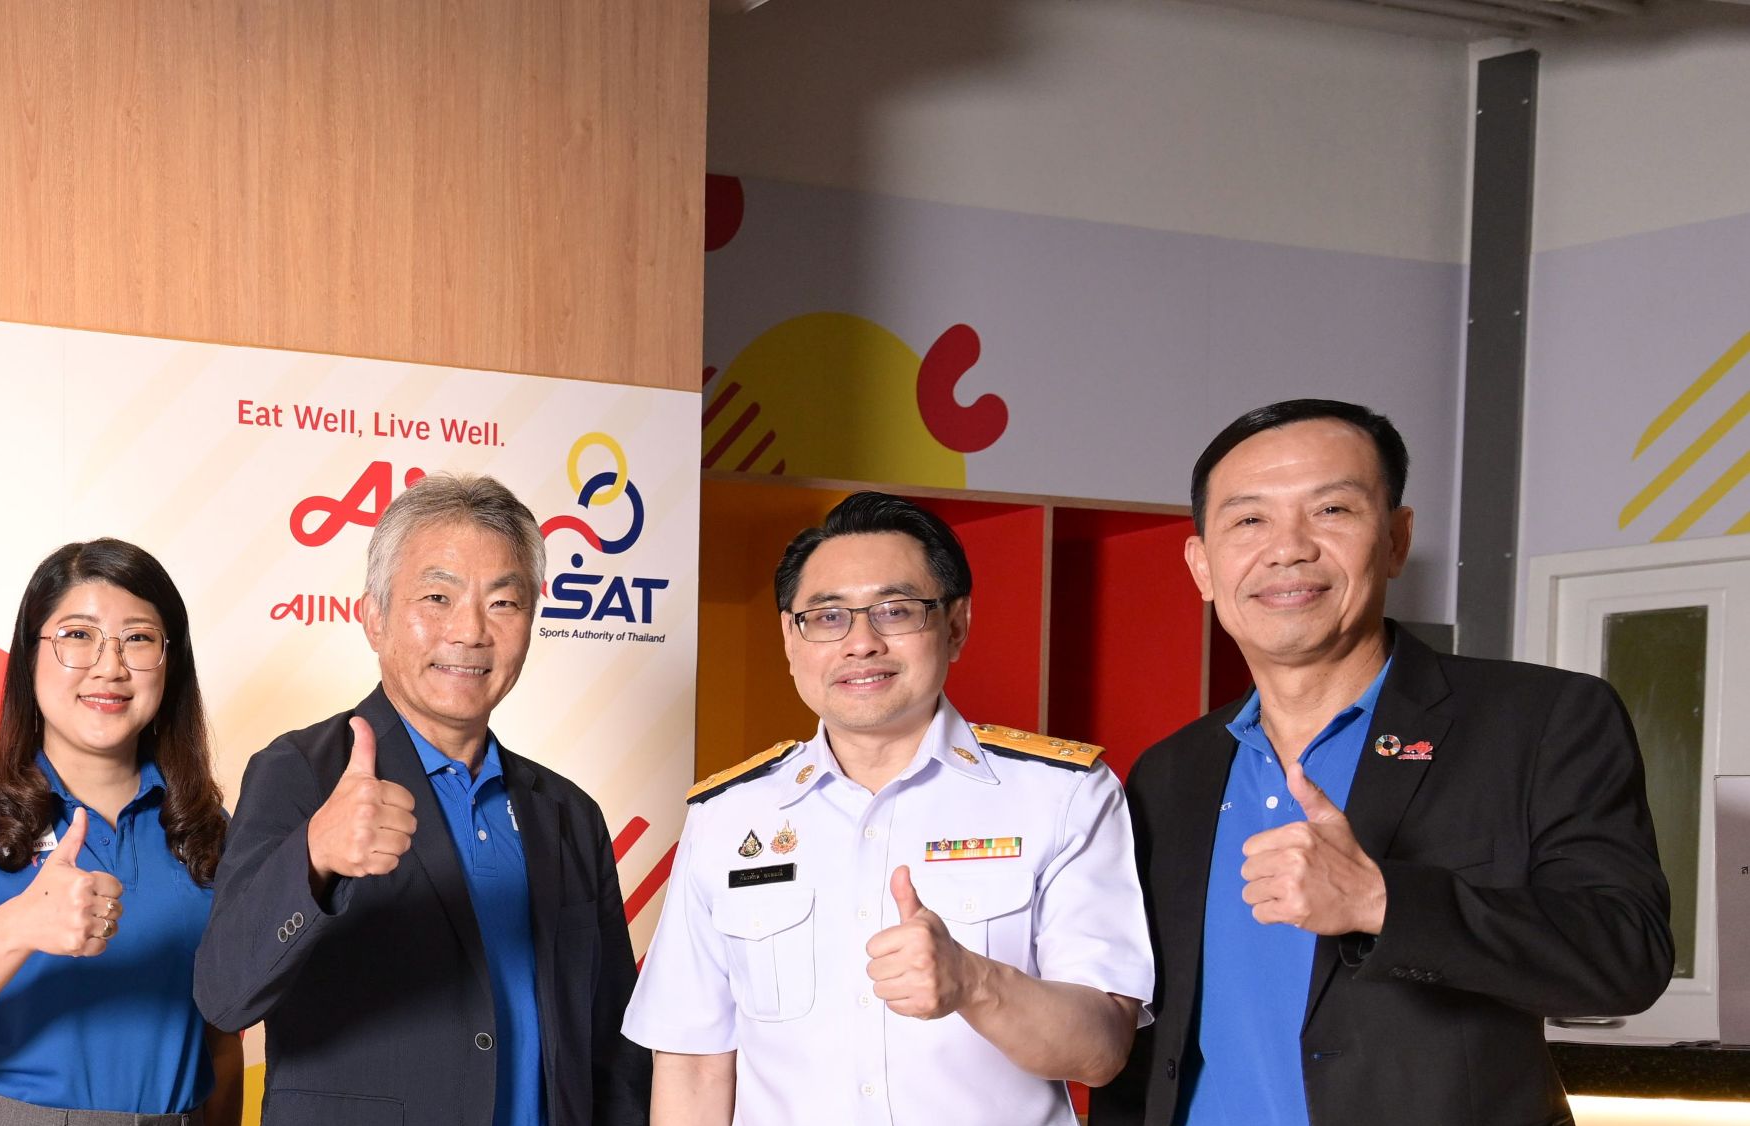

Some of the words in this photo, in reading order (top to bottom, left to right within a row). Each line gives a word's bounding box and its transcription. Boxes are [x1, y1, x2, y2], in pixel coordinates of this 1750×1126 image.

[238, 399, 283, 428] Eat
[293, 404, 363, 438] Well,
[374, 411, 430, 441] Live
[440, 417, 505, 447] Well.
[540, 572, 670, 624] SAT
[539, 627, 570, 638] Sports
[571, 629, 614, 642] Authority
[615, 632, 626, 641] of
[627, 632, 666, 643] Thailand
